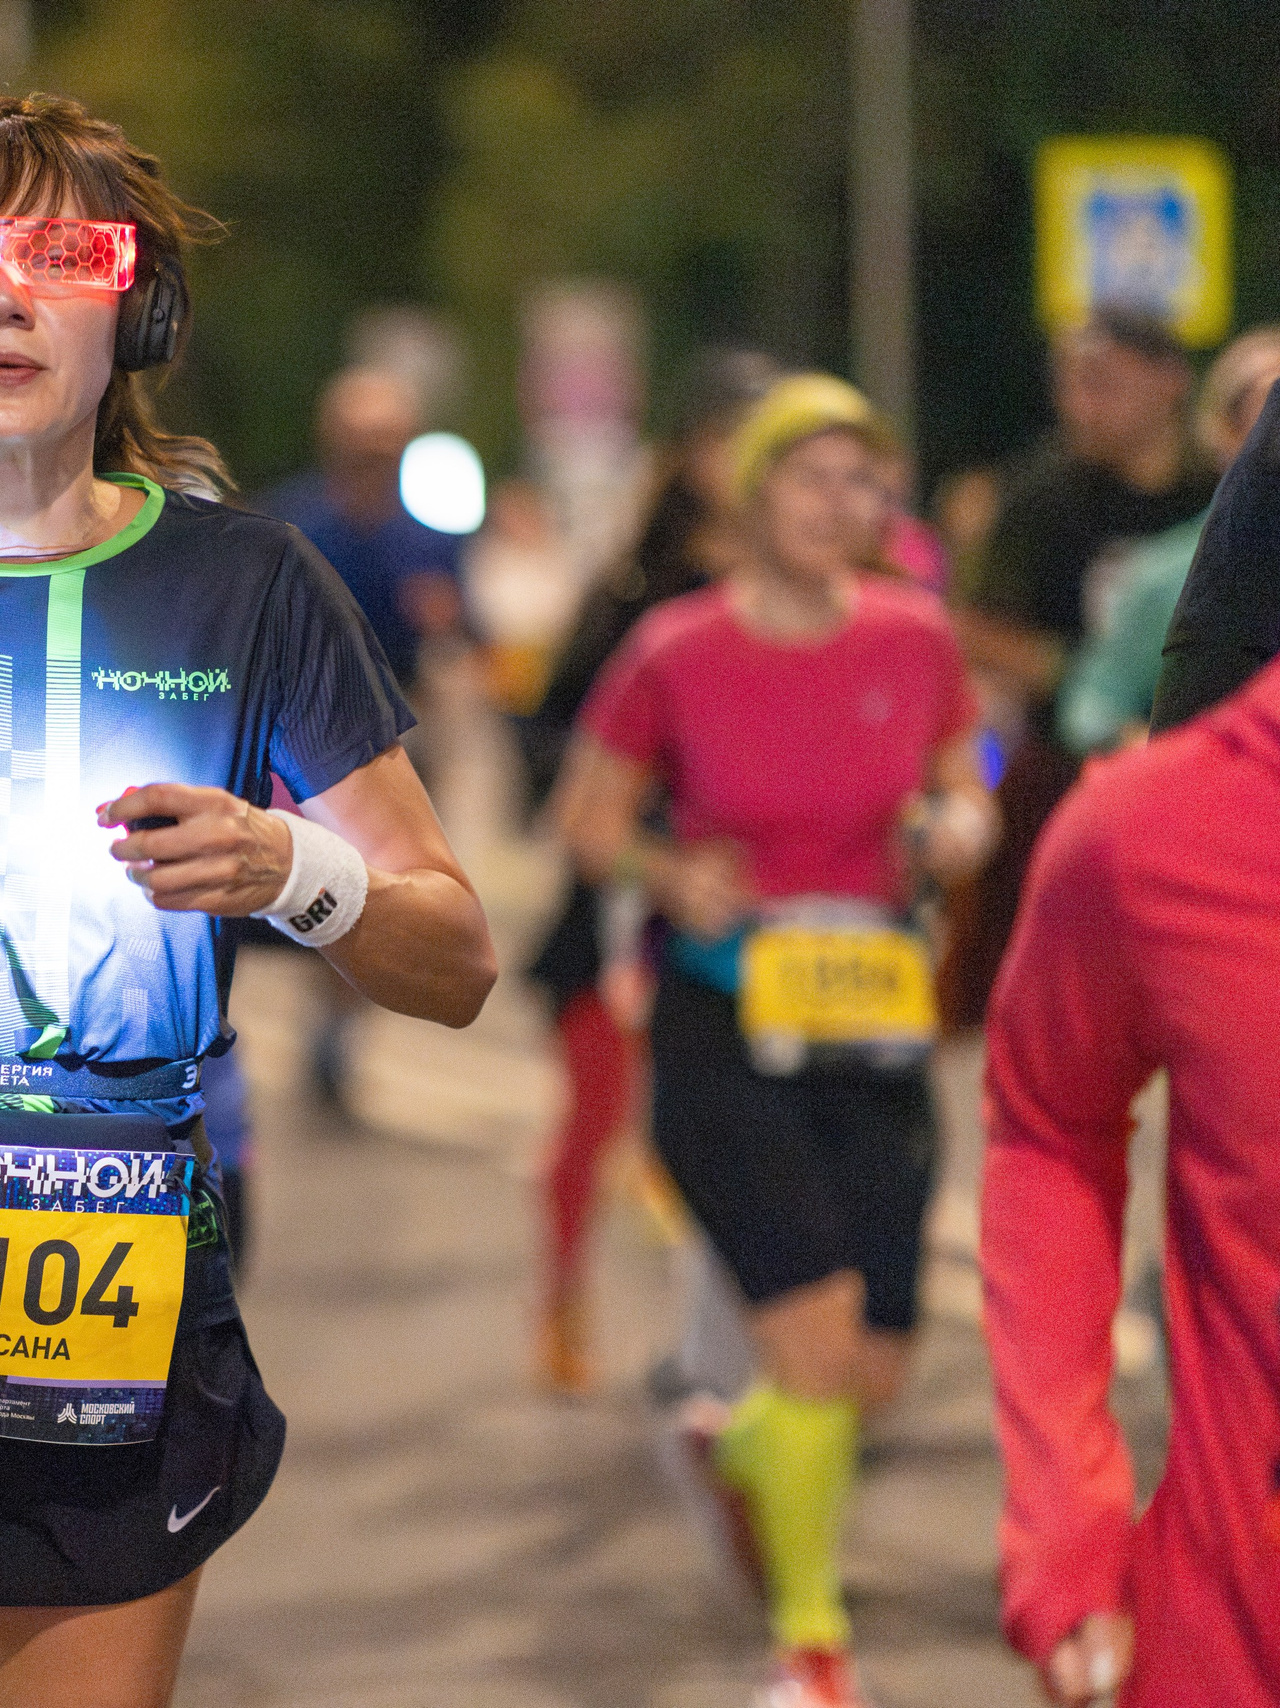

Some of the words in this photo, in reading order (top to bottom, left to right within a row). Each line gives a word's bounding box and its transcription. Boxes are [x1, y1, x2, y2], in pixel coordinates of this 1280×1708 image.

[91, 667, 232, 693] НОЧНОЙ
[158, 692, 210, 701] ЗАБЕГ
[31, 1198, 125, 1214] ЗАБЕГ
[80, 1400, 135, 1415] МОСКОВСКИЙ
[80, 1414, 107, 1425] СПОРТ
